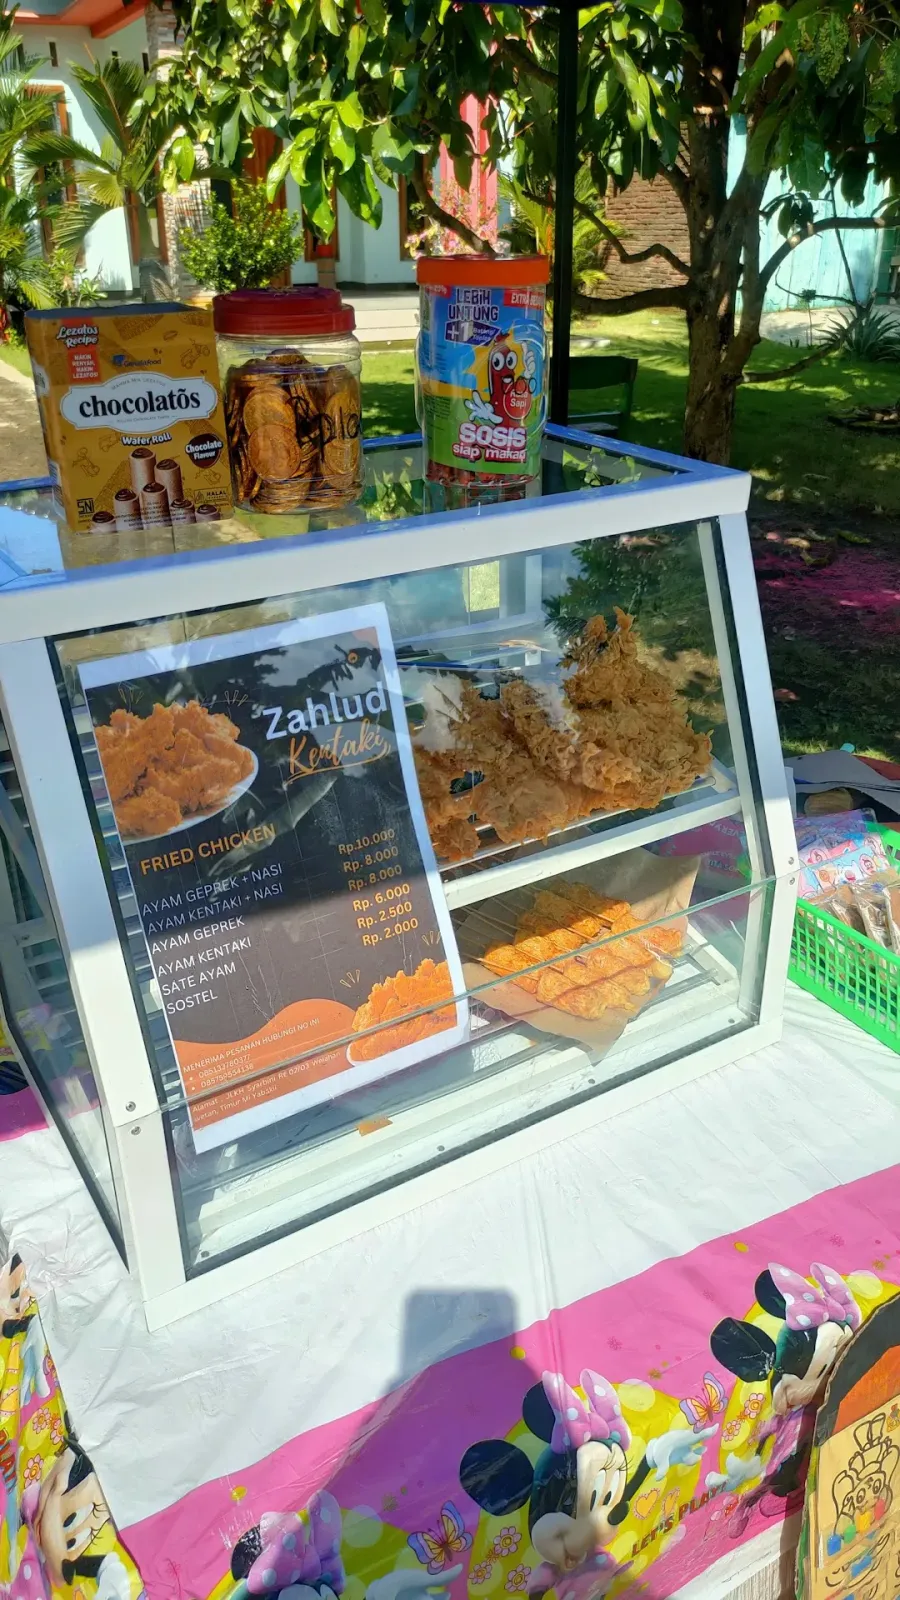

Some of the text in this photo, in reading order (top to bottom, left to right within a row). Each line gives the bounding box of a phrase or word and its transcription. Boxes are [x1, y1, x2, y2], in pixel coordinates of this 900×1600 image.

[449, 304, 499, 320] UNTUNG
[57, 324, 98, 339] Lezatos
[65, 335, 98, 348] Recipe
[510, 398, 527, 410] Sapi
[122, 433, 172, 445] Wafer Roll
[185, 440, 222, 452] Chocolate
[459, 422, 527, 448] SOSIS
[194, 451, 216, 460] Flavour
[452, 442, 481, 460] siap
[262, 681, 388, 741] Zahlud
[289, 718, 385, 775] Kentaki
[140, 824, 275, 875] FRIED CHICKEN
[343, 846, 399, 873] Rp. 8.000
[142, 893, 182, 917] AYAM
[185, 876, 239, 903] GEPREK
[251, 863, 283, 883] NASI
[348, 864, 402, 892] Rp. 8.000
[148, 912, 186, 935] AYAM
[189, 894, 241, 922] KENTAKI
[254, 882, 284, 902] NASI
[352, 883, 410, 912] Rp. 6.000
[356, 901, 412, 929] Rp. 2.500
[152, 915, 245, 954] AYAM GEPREK
[362, 917, 419, 946] Rp. 2.000
[157, 936, 252, 978] AYAM KENTAKI
[162, 962, 237, 997] SATE AYAM
[166, 990, 218, 1015] SOSTEL
[183, 1018, 320, 1073] MENERIMA PESANAN HUBUNGI NO INI
[192, 1098, 218, 1112] Alamat
[289, 1064, 310, 1076] 02/03
[220, 1100, 240, 1114] Timur
[631, 1514, 674, 1558] LET'S
